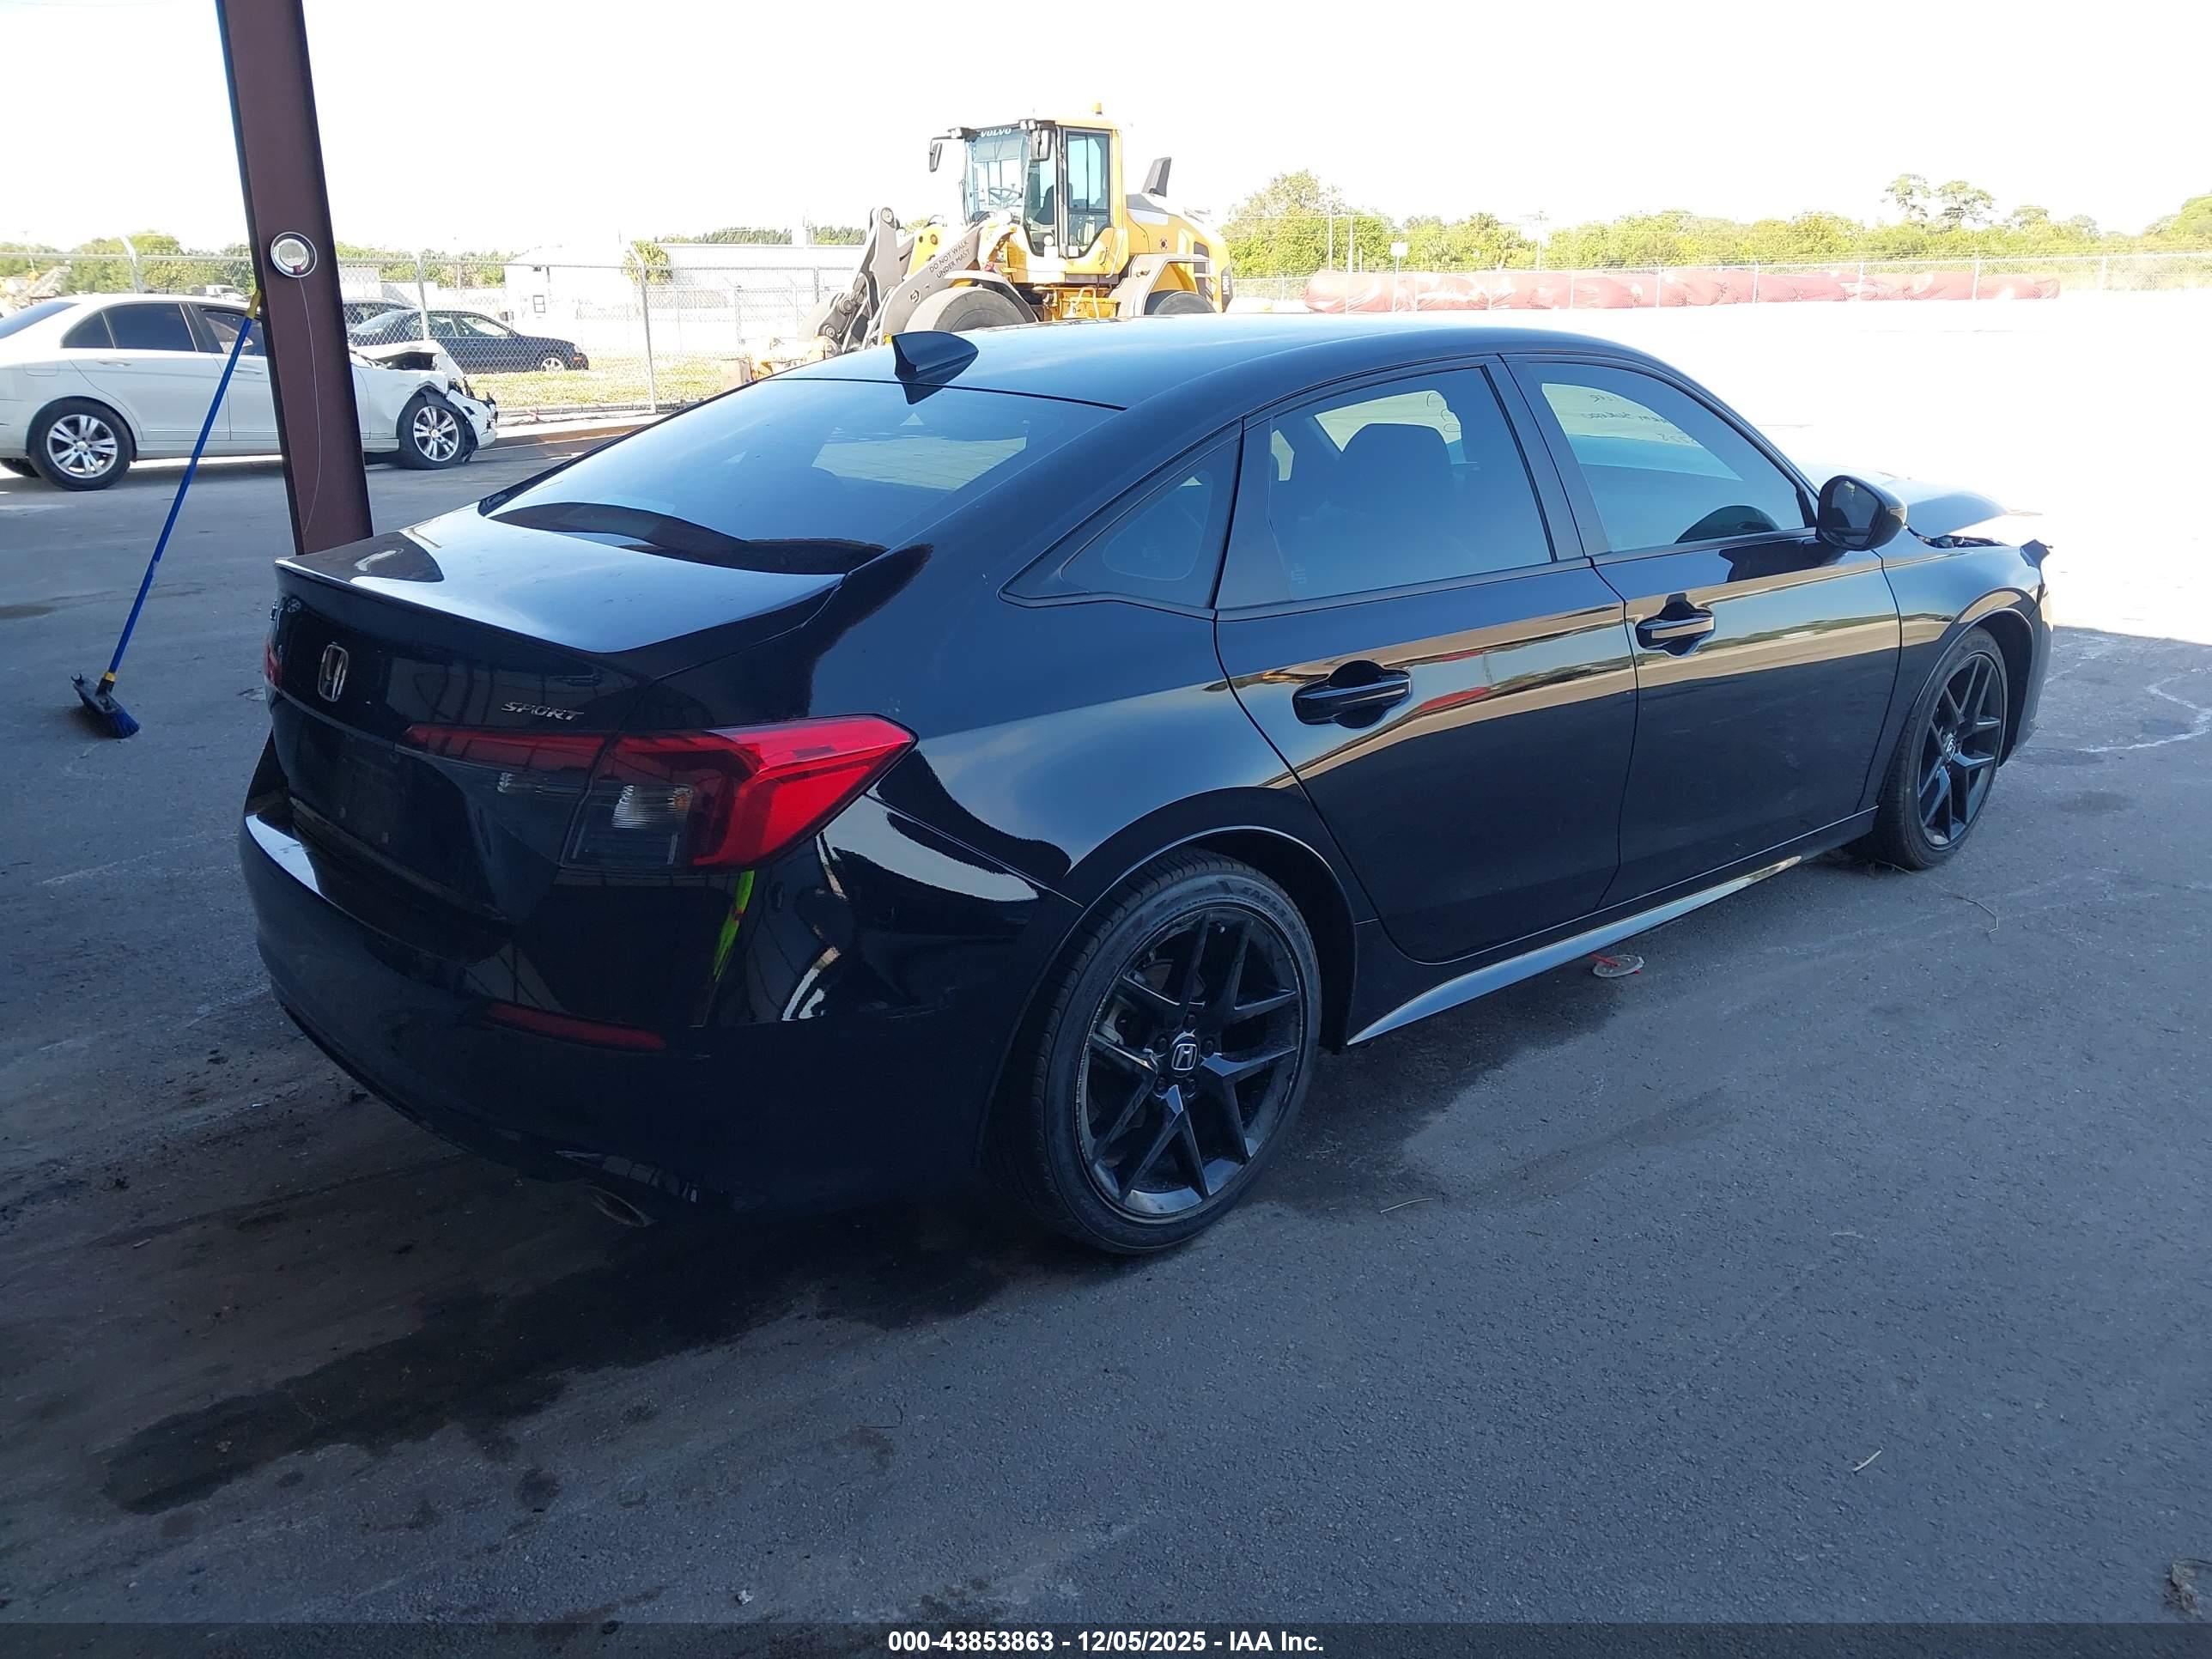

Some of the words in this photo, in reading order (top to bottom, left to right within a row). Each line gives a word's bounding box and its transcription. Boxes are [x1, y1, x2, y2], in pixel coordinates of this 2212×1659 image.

[981, 128, 1012, 138] VOLVO
[929, 262, 939, 273] DO
[939, 252, 951, 265] NOT
[951, 240, 969, 254] WALK
[936, 260, 956, 278] UNDER
[955, 248, 970, 264] MAST
[501, 701, 585, 721] SPORT
